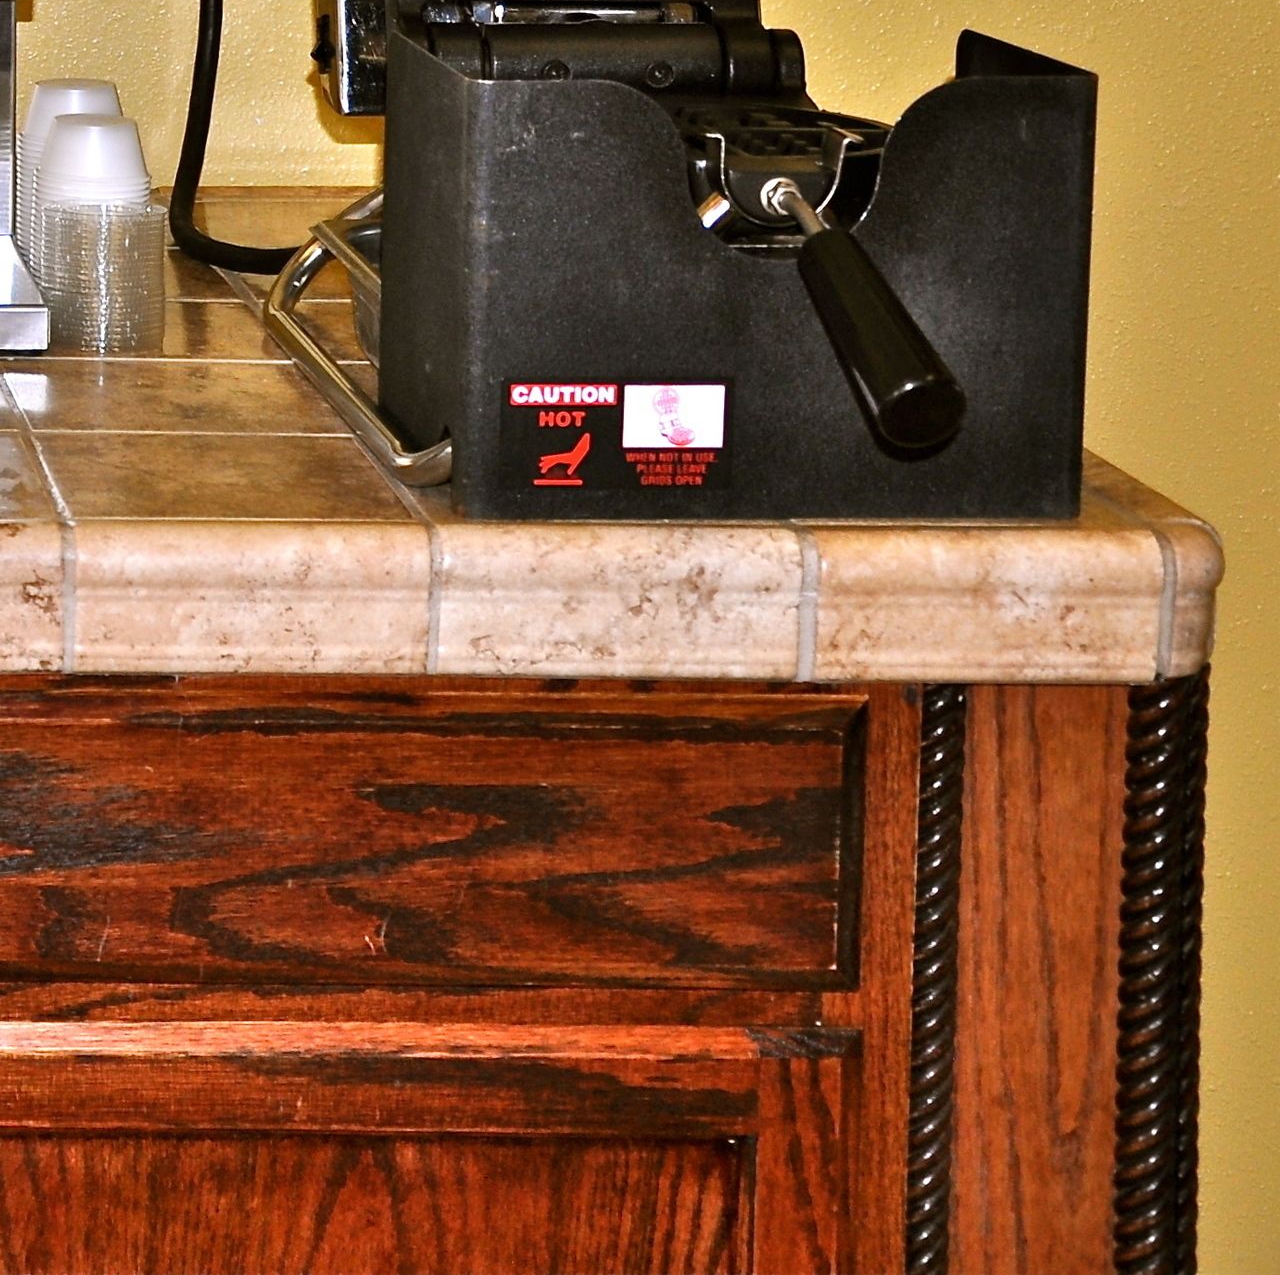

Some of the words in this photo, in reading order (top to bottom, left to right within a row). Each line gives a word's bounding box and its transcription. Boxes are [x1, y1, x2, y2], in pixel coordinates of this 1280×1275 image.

[511, 386, 614, 404] CAUTION
[539, 411, 586, 427] HOT
[626, 452, 656, 462] WHEN
[659, 452, 678, 462] NOT
[682, 452, 693, 462] IN
[636, 464, 673, 474] PLEASE
[676, 464, 706, 474] LEAVE
[641, 475, 672, 485] GRIDS
[675, 475, 702, 485] OPEN
